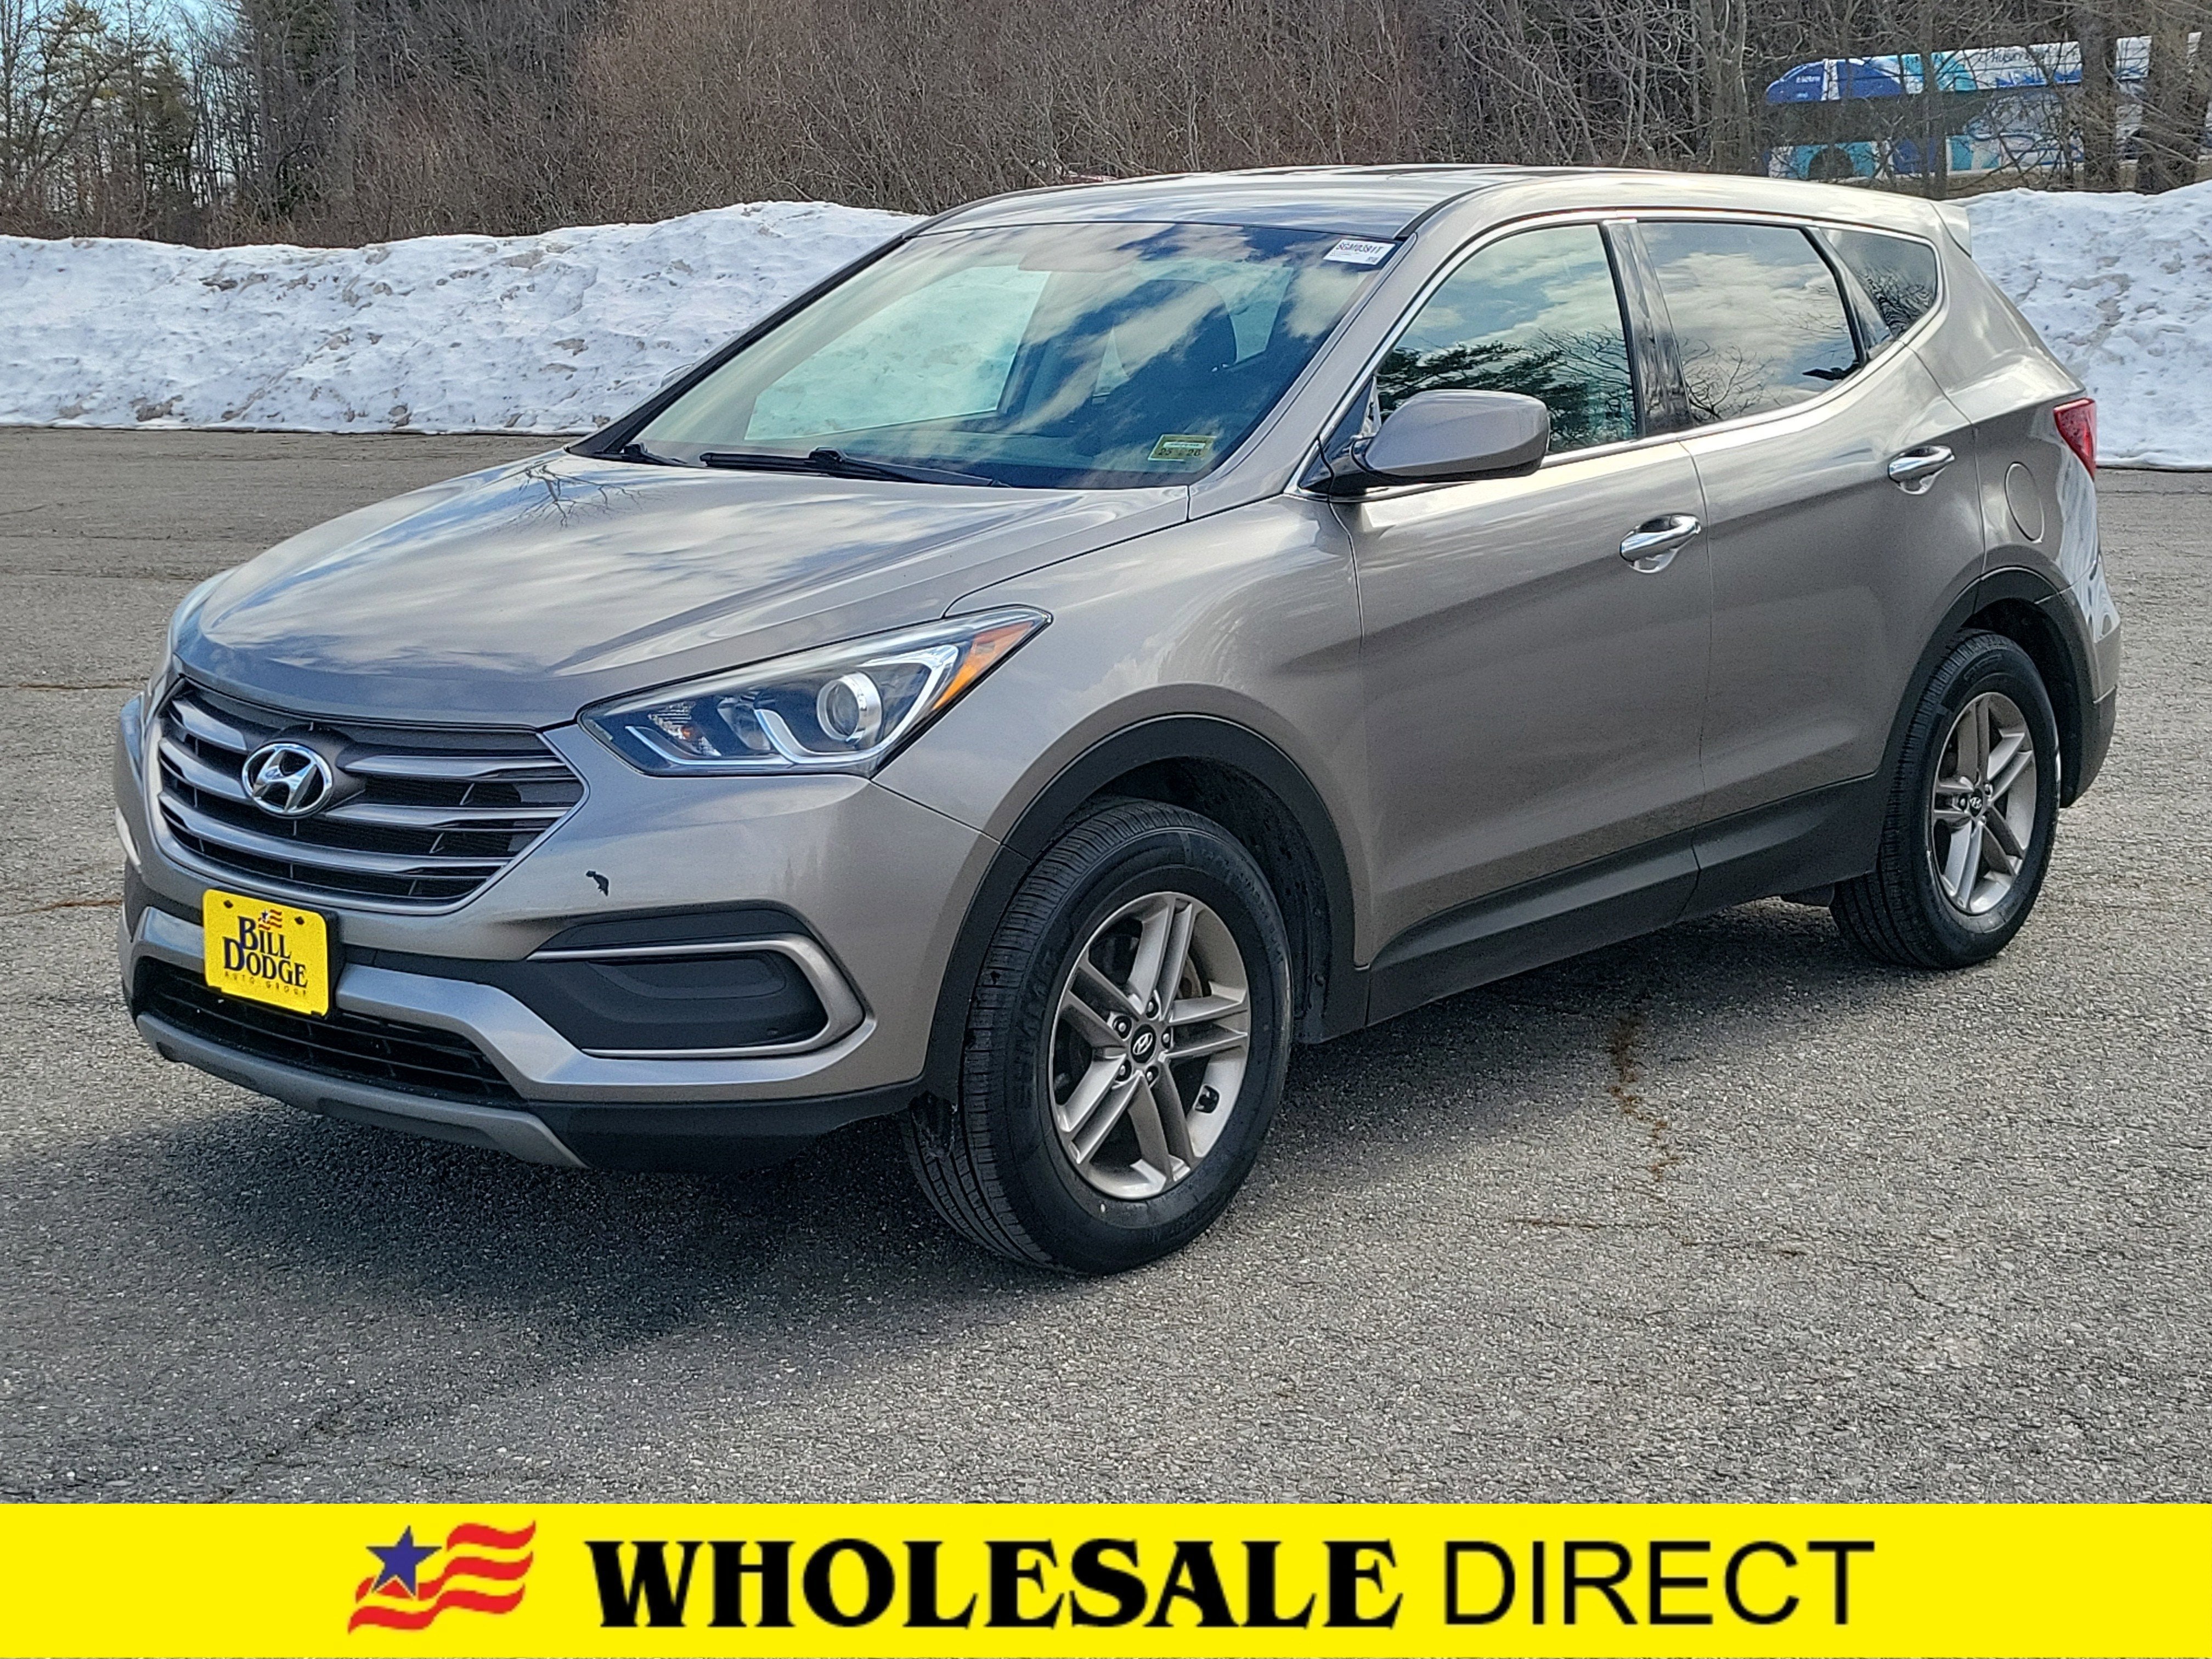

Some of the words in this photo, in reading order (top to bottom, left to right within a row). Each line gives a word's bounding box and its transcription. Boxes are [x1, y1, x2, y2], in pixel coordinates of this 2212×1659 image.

[237, 915, 292, 959] BILL
[222, 936, 308, 988] DODGE
[224, 970, 255, 985] AUTO
